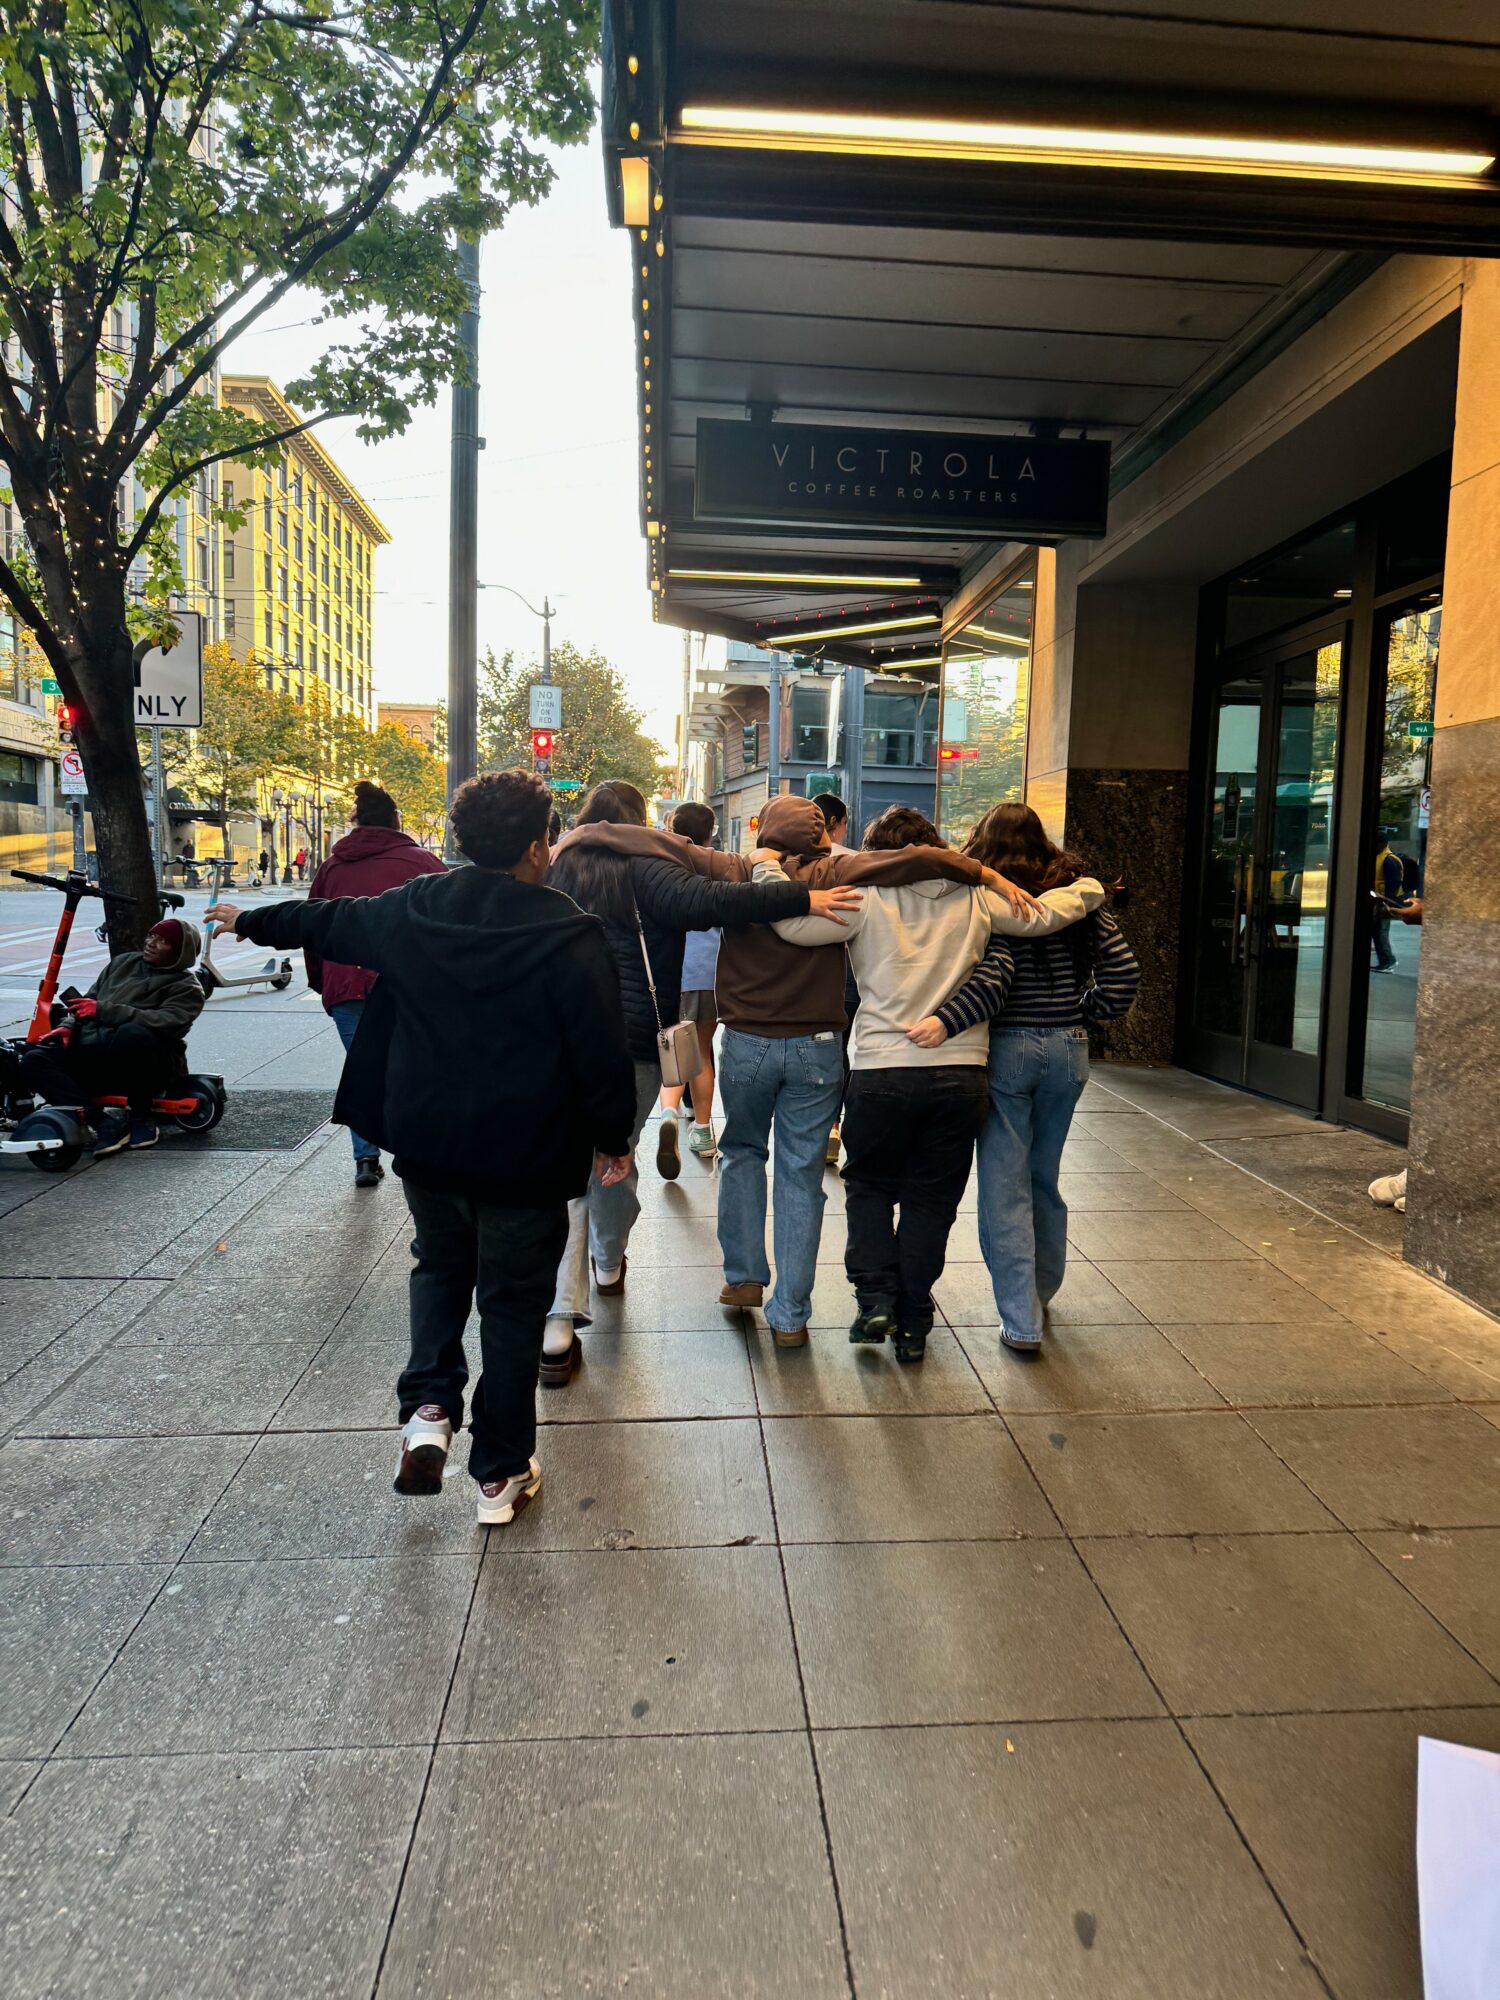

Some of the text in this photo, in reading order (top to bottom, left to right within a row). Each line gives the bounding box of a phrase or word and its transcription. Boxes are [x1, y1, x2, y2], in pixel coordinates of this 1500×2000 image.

[772, 443, 1036, 481] VICTROLA
[788, 481, 1018, 503] COFFEE ROASTERS
[137, 694, 188, 717] NLY
[536, 700, 555, 708] TURN
[538, 690, 553, 700] NO
